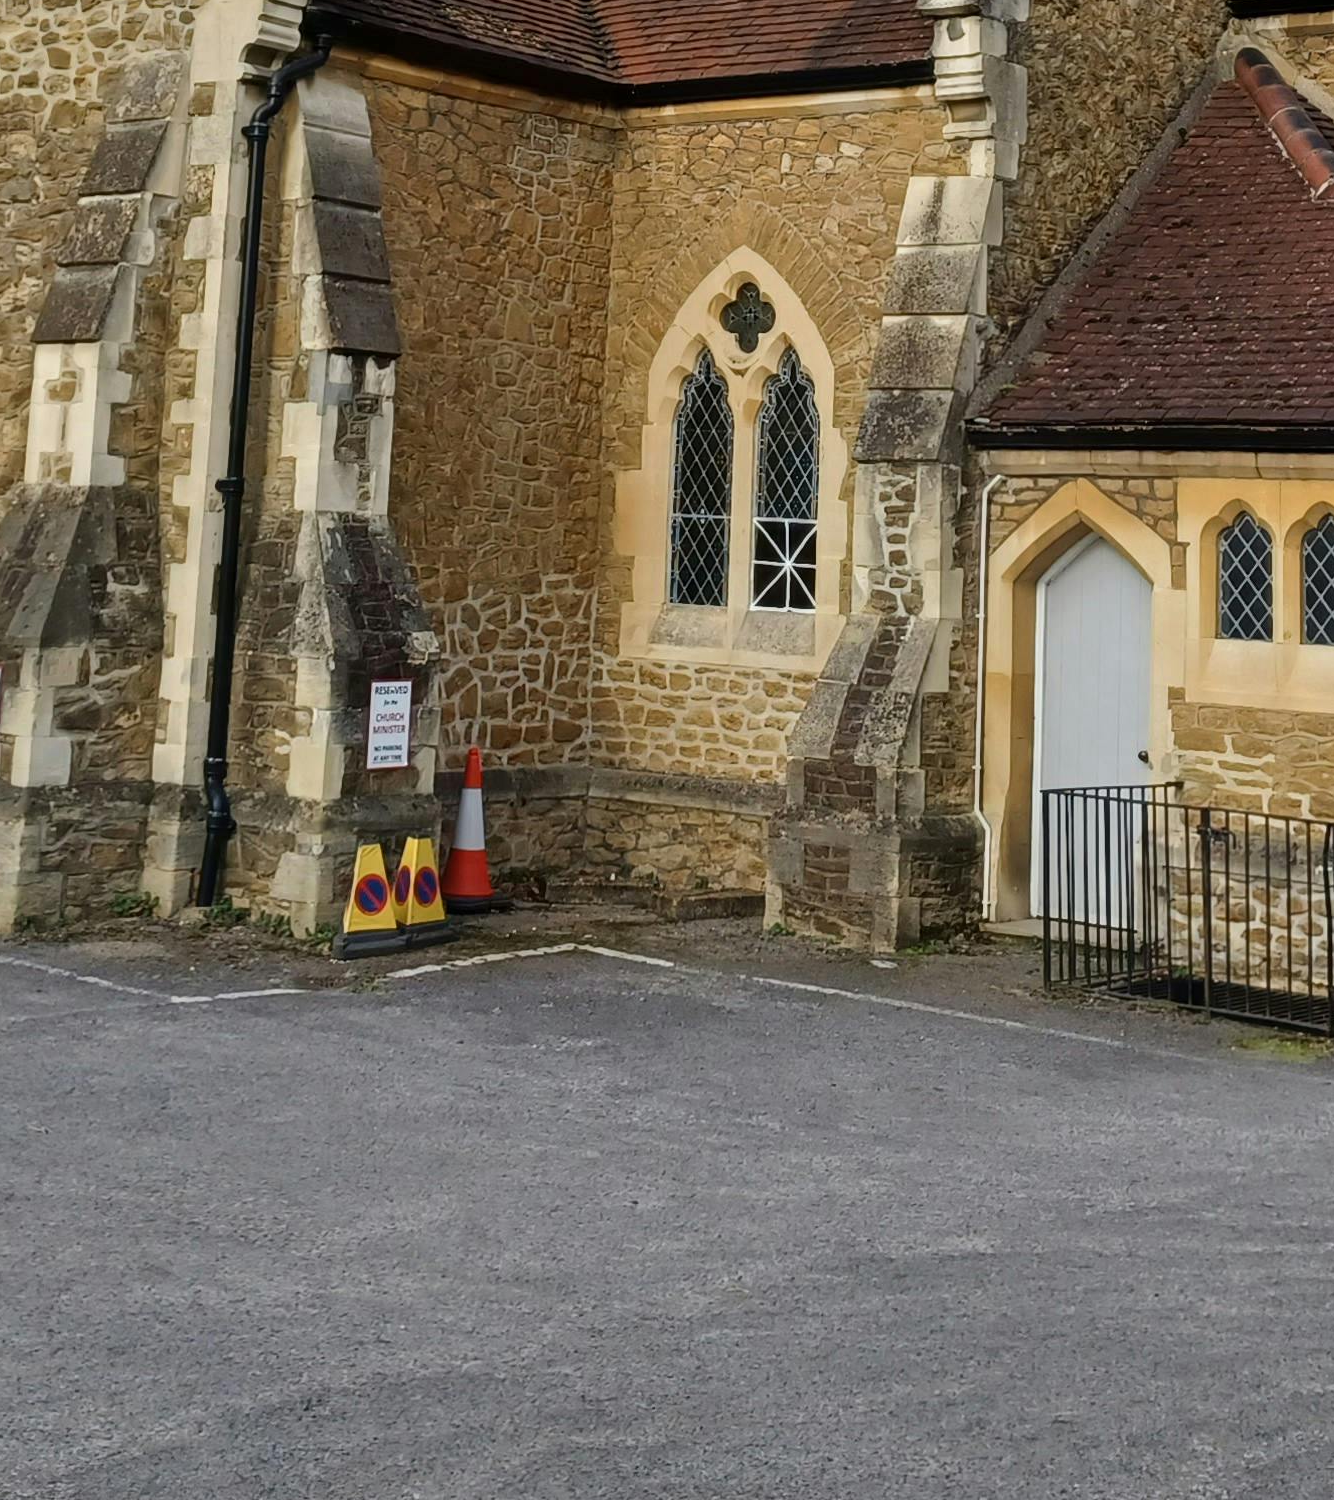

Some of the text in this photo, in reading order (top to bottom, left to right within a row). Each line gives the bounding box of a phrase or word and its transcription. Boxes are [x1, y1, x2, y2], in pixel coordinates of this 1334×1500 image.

[374, 686, 409, 695] RESERVED
[375, 712, 405, 723] CHURCH
[372, 725, 407, 734] MINISTER
